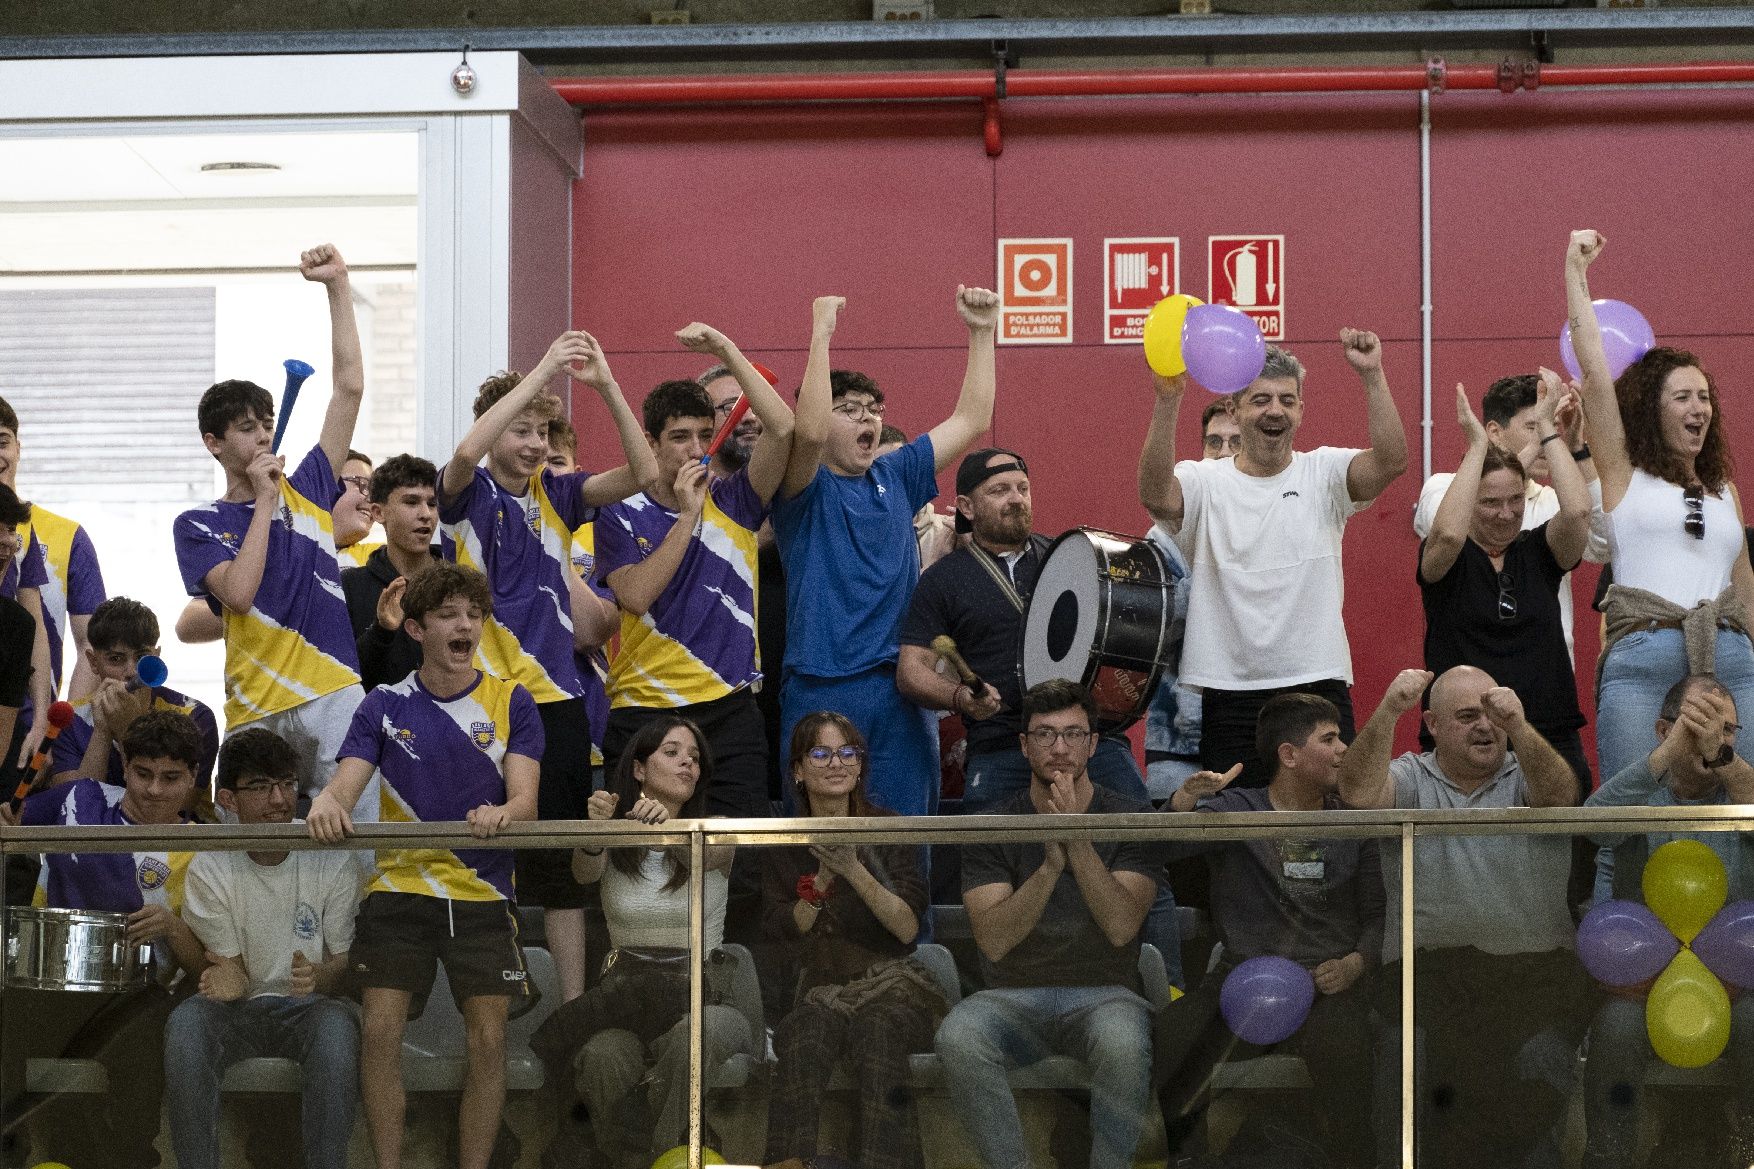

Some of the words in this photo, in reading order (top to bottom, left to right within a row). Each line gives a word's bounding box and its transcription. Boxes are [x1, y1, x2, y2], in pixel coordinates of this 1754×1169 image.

[1008, 315, 1062, 325] POLSADOR
[1126, 317, 1146, 327] BO
[1010, 326, 1061, 335] D'ALARMA
[1113, 327, 1145, 336] D'INC
